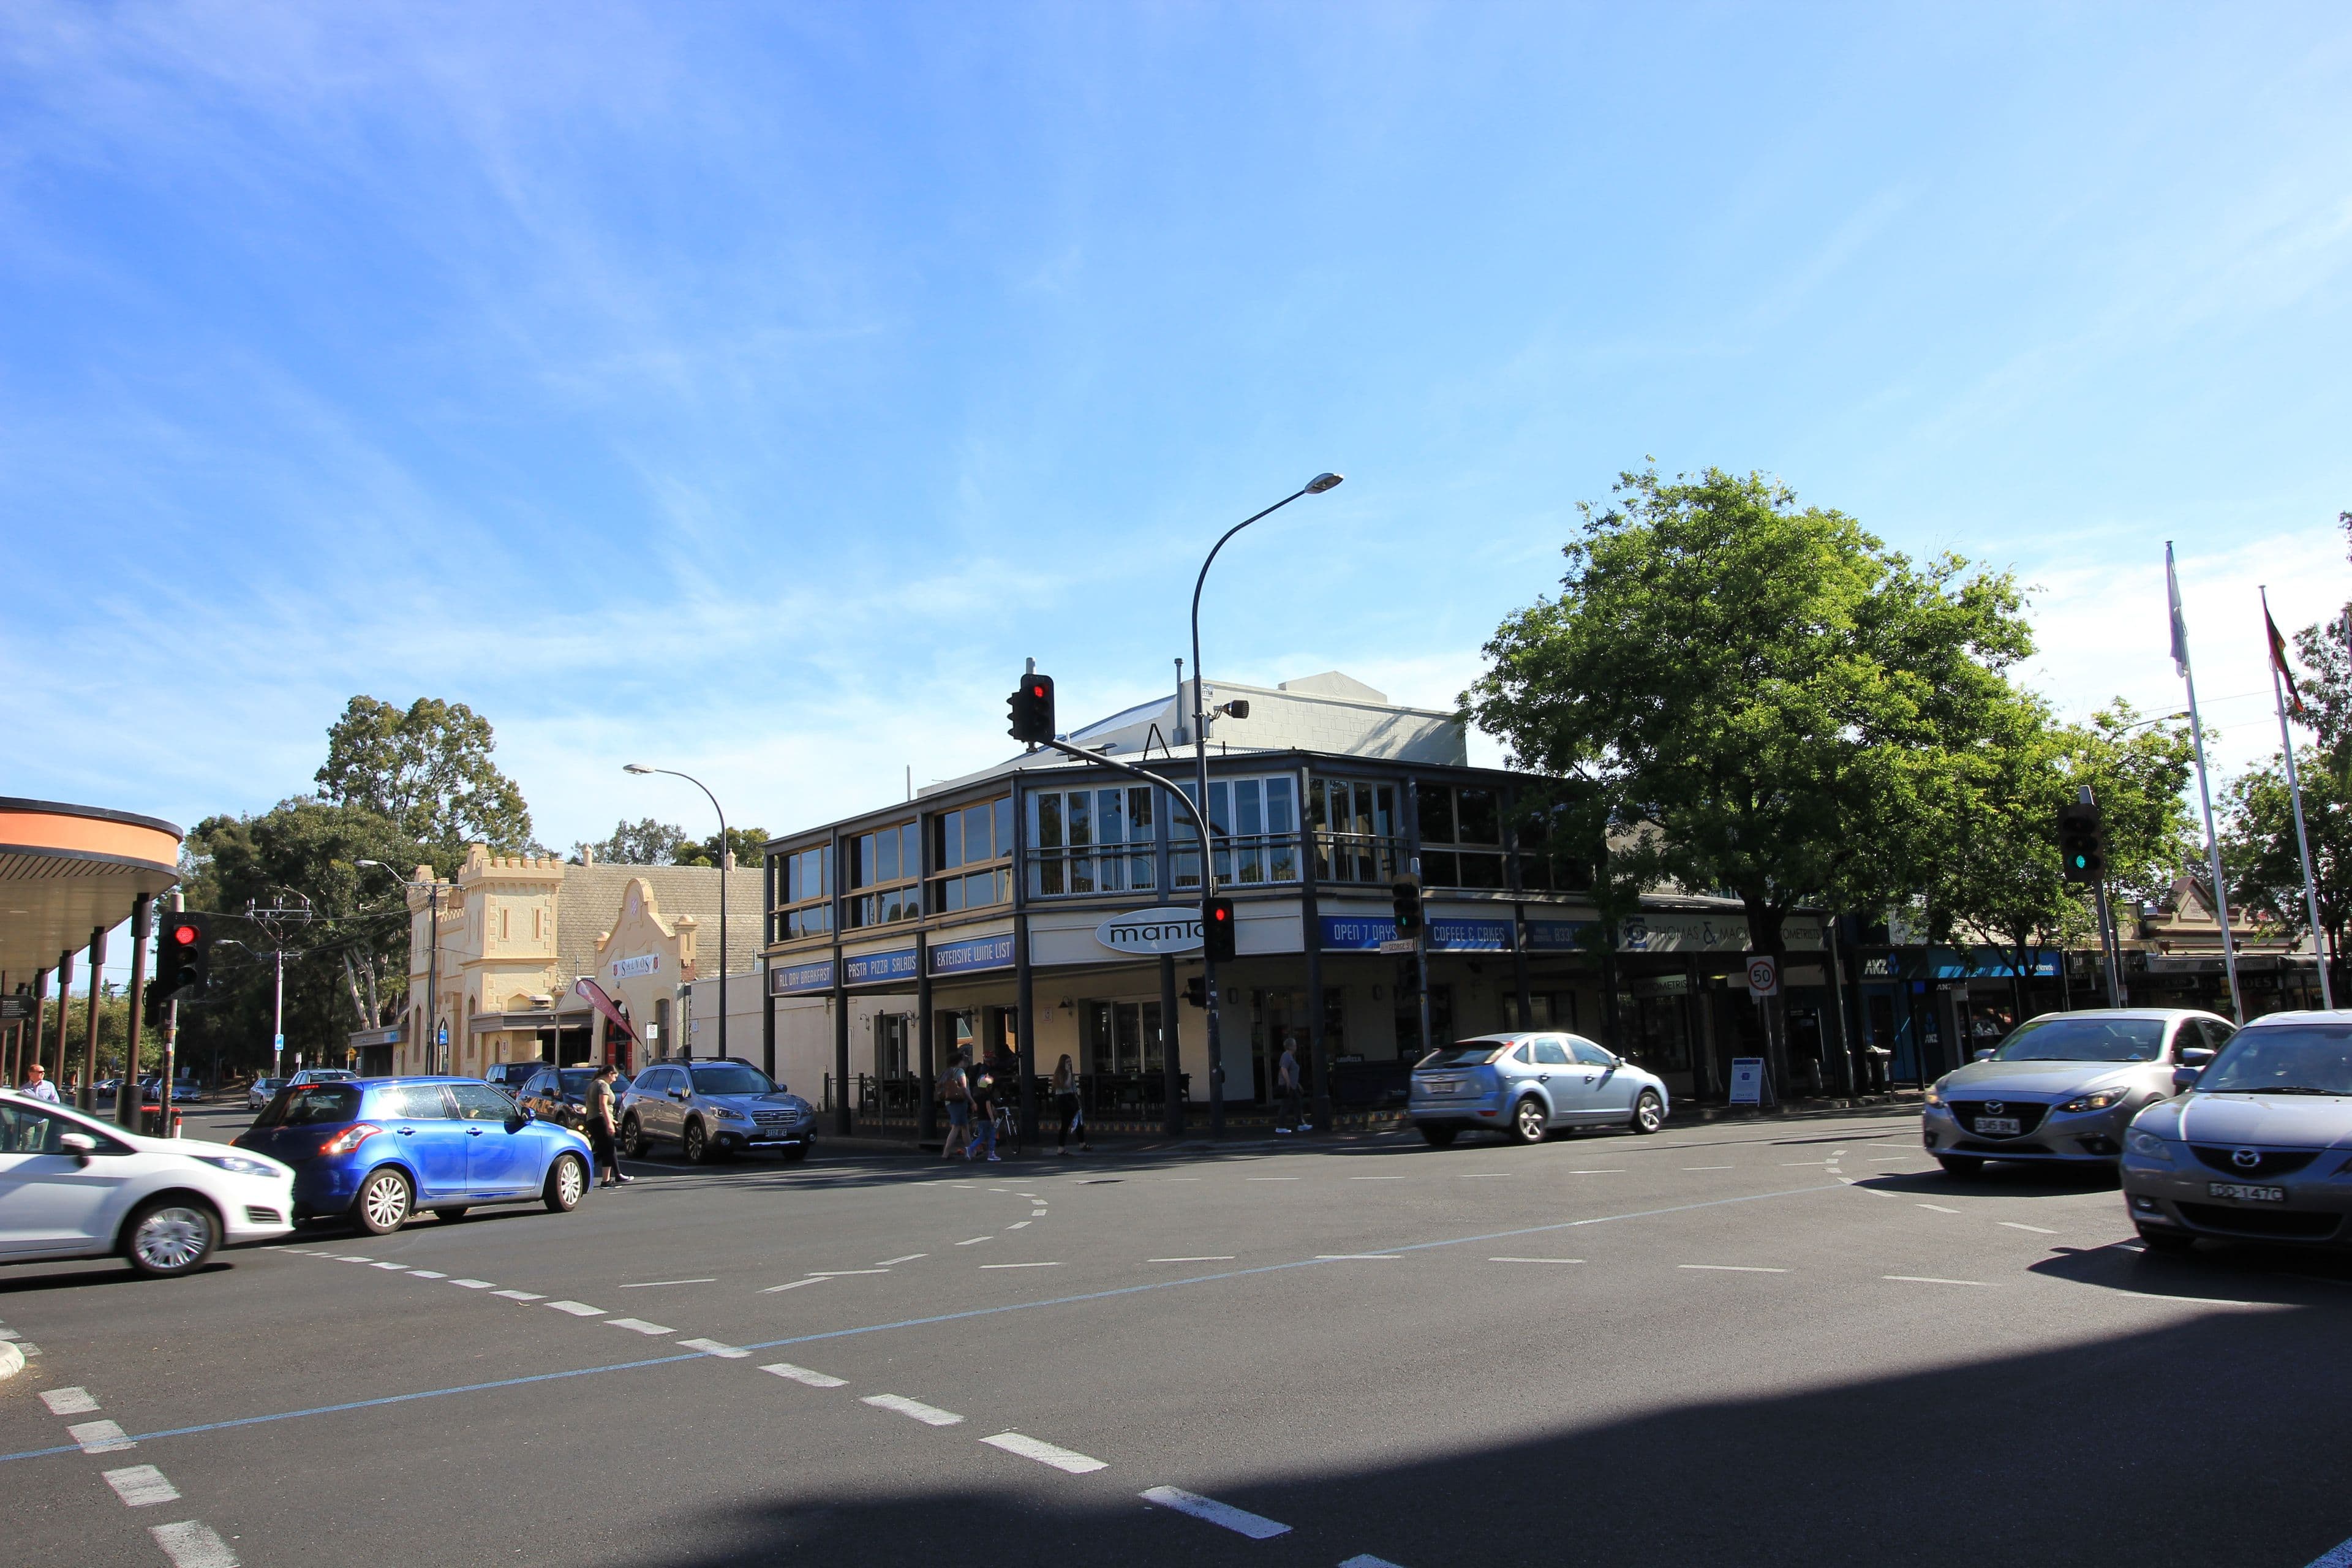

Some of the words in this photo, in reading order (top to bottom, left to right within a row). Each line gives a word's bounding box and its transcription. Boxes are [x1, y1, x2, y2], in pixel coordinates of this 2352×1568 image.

[1334, 924, 1359, 940] OPEN
[1363, 925, 1368, 940] 7
[1372, 925, 1397, 940] DAYS
[1434, 926, 1465, 941] COFFEE
[1477, 927, 1505, 941] CAKES
[1654, 925, 1699, 940] THOMAS
[1783, 928, 1820, 940] OMETRISTS
[937, 948, 971, 967] EXTENSIVE
[974, 944, 993, 962] WINE
[995, 941, 1010, 959] LIST
[1389, 942, 1406, 951] GEORGE
[621, 956, 650, 976] SALVOS
[848, 962, 867, 978] PASTA
[871, 959, 888, 974] PIZZA
[892, 956, 916, 973] SALADS
[1864, 959, 1888, 975] ANZ
[779, 974, 788, 987] ALL
[789, 972, 799, 986] DAY
[801, 967, 830, 984] BREAKFAST
[1754, 970, 1771, 982] 50
[1636, 980, 1687, 991] OPTOMETRIS
[1924, 1033, 1939, 1043] ANZ
